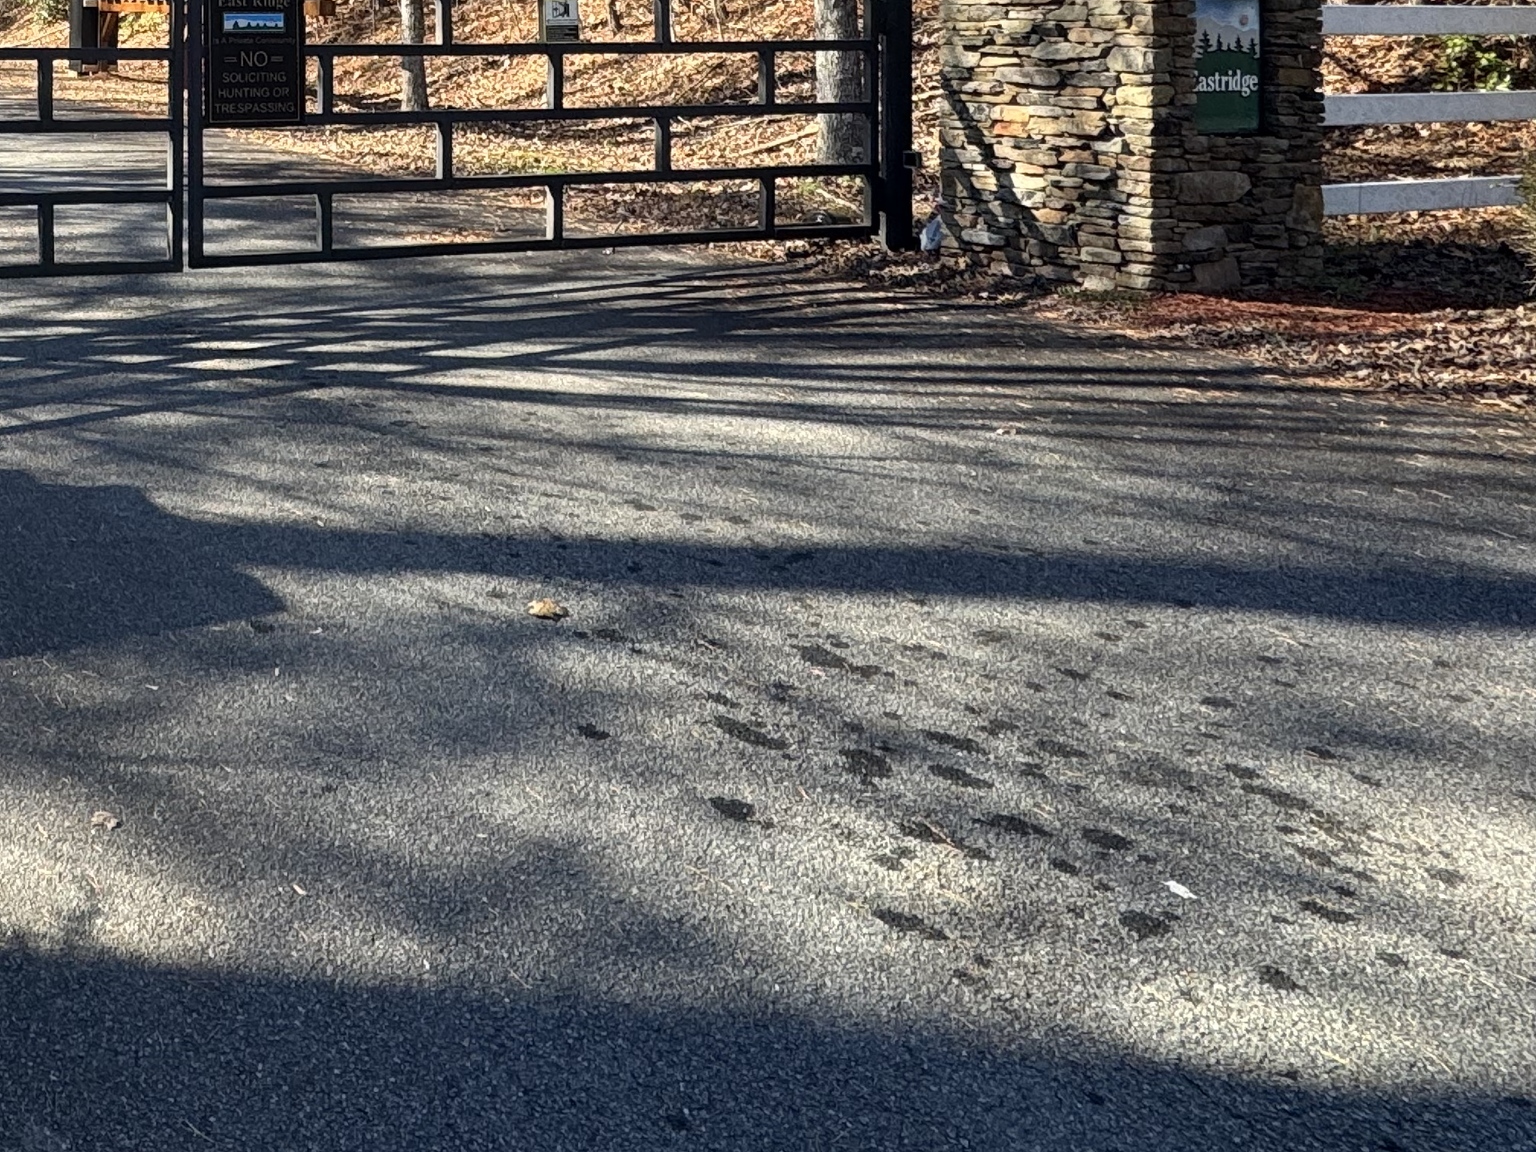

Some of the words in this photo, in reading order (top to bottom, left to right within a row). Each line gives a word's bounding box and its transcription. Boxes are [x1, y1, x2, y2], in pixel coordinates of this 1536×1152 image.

[240, 51, 268, 67] NO
[222, 71, 287, 83] SOLICITING
[218, 87, 270, 99] HUNTING
[272, 87, 290, 97] OR
[215, 102, 295, 114] TRESPASSING
